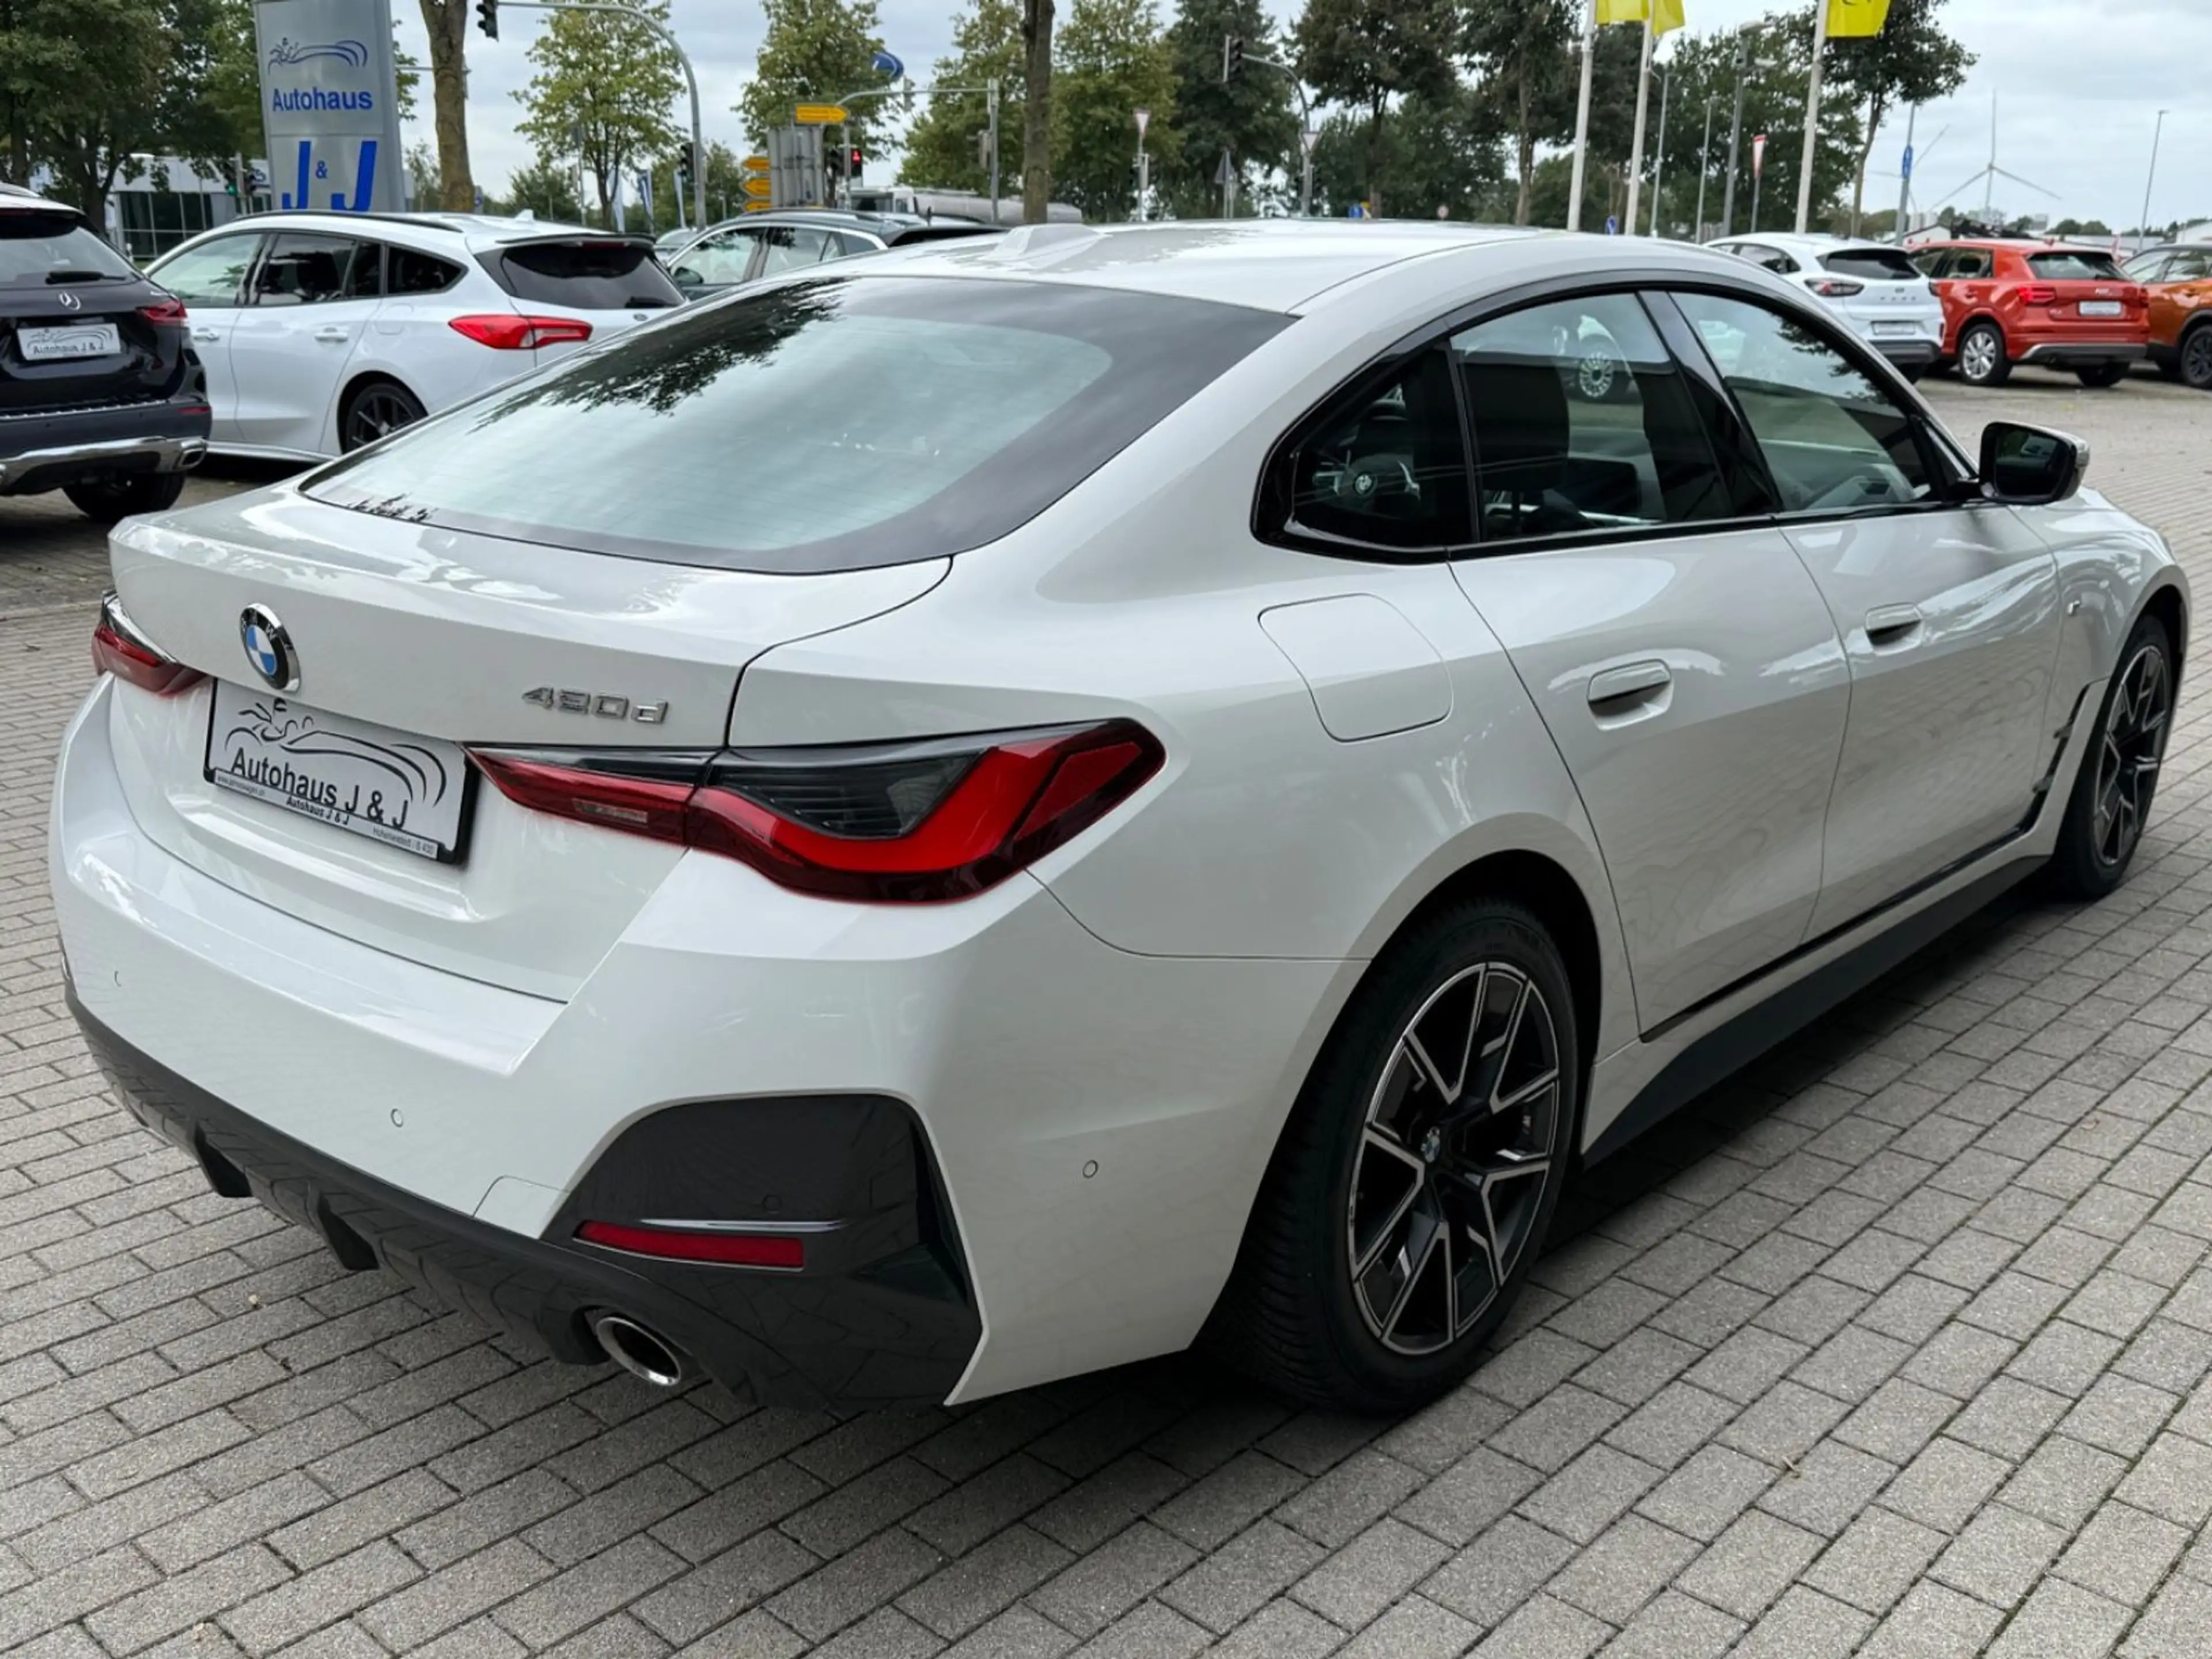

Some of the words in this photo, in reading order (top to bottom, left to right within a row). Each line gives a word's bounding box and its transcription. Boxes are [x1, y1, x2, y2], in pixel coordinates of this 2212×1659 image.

[272, 86, 373, 112] Autohaus
[282, 141, 312, 210] J
[315, 161, 328, 179] &
[331, 141, 377, 212] J
[33, 344, 79, 355] Autohaus
[231, 747, 337, 806] Autohaus
[344, 784, 360, 814] J
[366, 790, 384, 824] &
[392, 799, 408, 829] J
[286, 796, 325, 818] Autohaus
